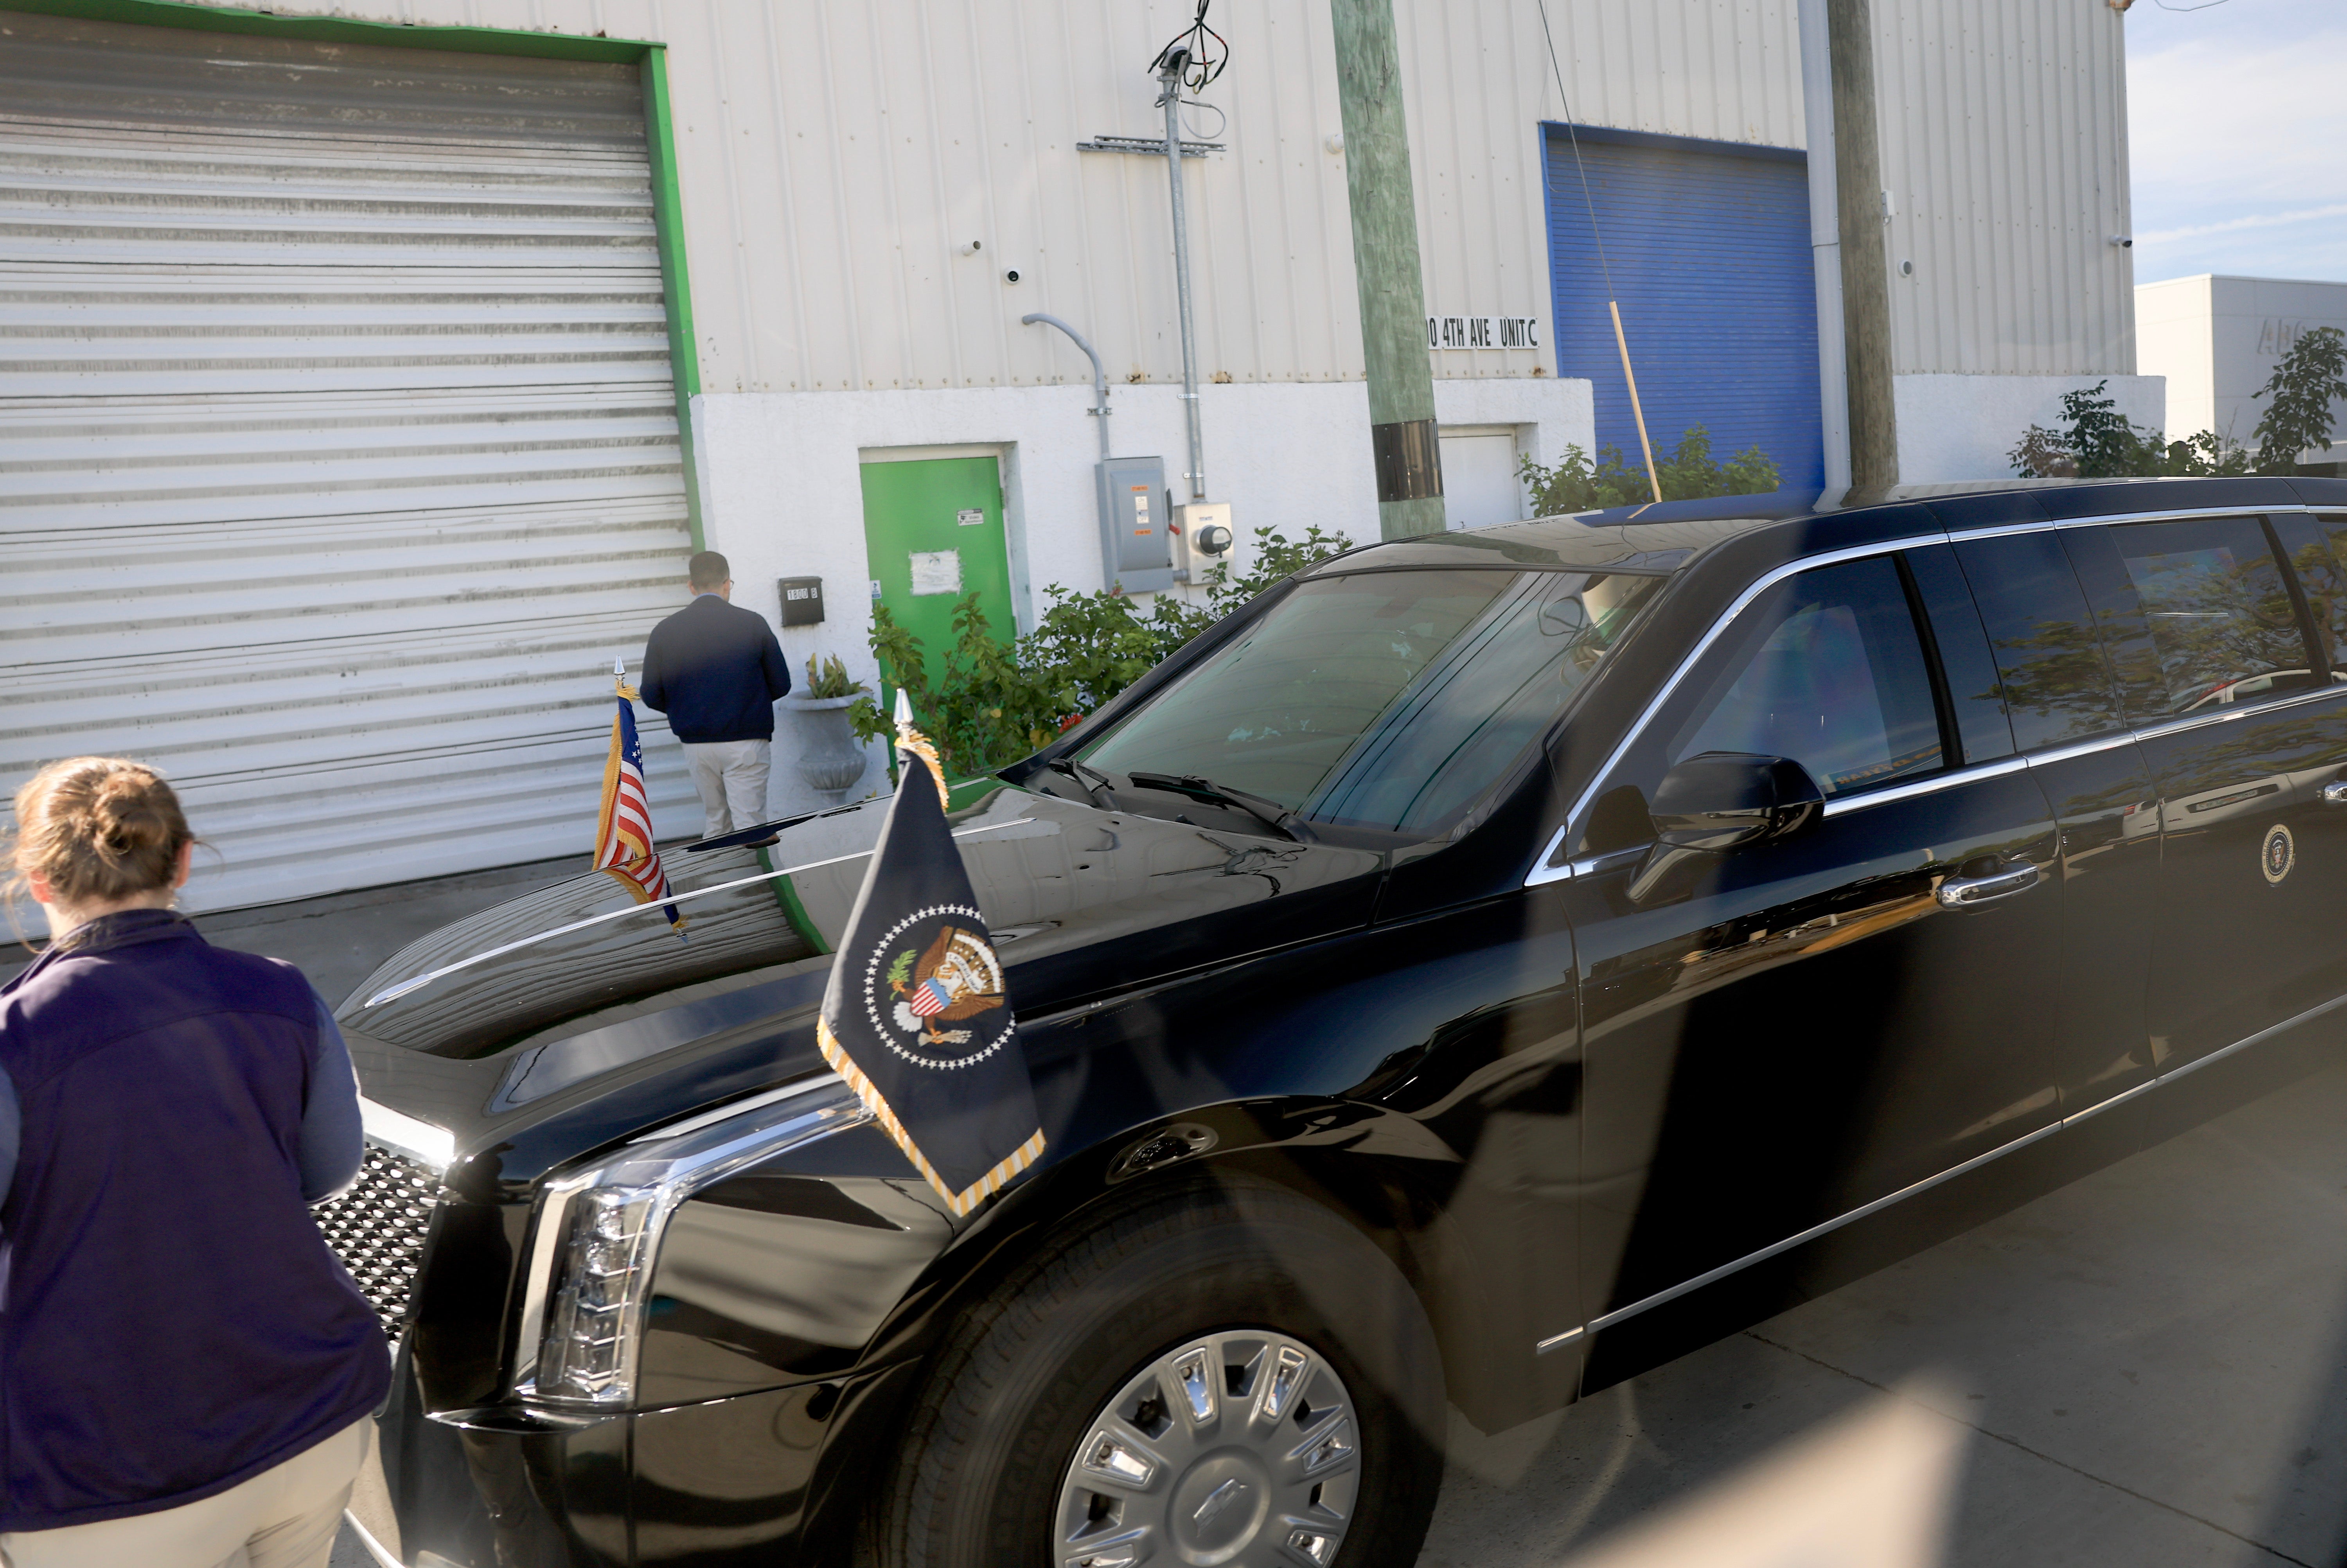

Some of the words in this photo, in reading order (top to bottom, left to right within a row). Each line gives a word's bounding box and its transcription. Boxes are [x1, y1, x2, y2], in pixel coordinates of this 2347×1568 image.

[1425, 318, 1437, 347] 0
[1443, 318, 1464, 346] 4TH
[1471, 319, 1491, 346] AVE
[1500, 319, 1525, 347] UNIT
[1528, 319, 1537, 346] C
[787, 589, 808, 600] 1800
[811, 588, 817, 598] B
